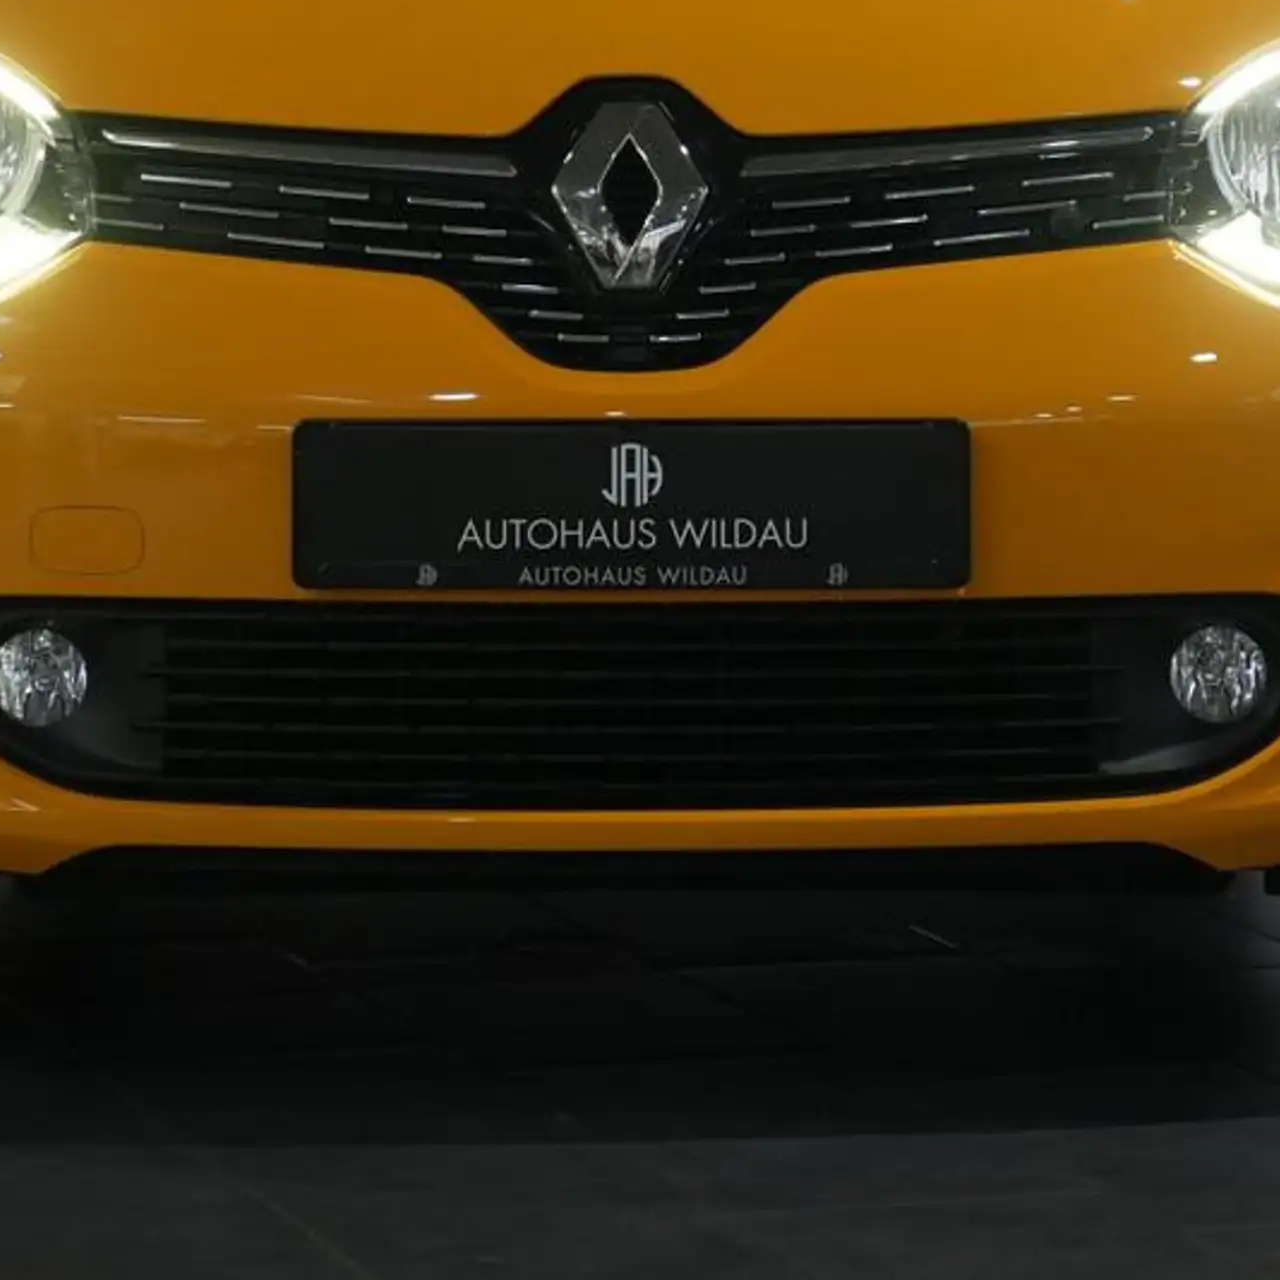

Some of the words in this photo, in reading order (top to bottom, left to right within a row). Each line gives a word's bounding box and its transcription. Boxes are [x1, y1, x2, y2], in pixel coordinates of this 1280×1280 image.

[457, 516, 657, 552] AUTOHAUS
[669, 516, 808, 552] WILDAU
[518, 565, 646, 586] AUTOHAUS
[657, 565, 747, 586] WILDAU
